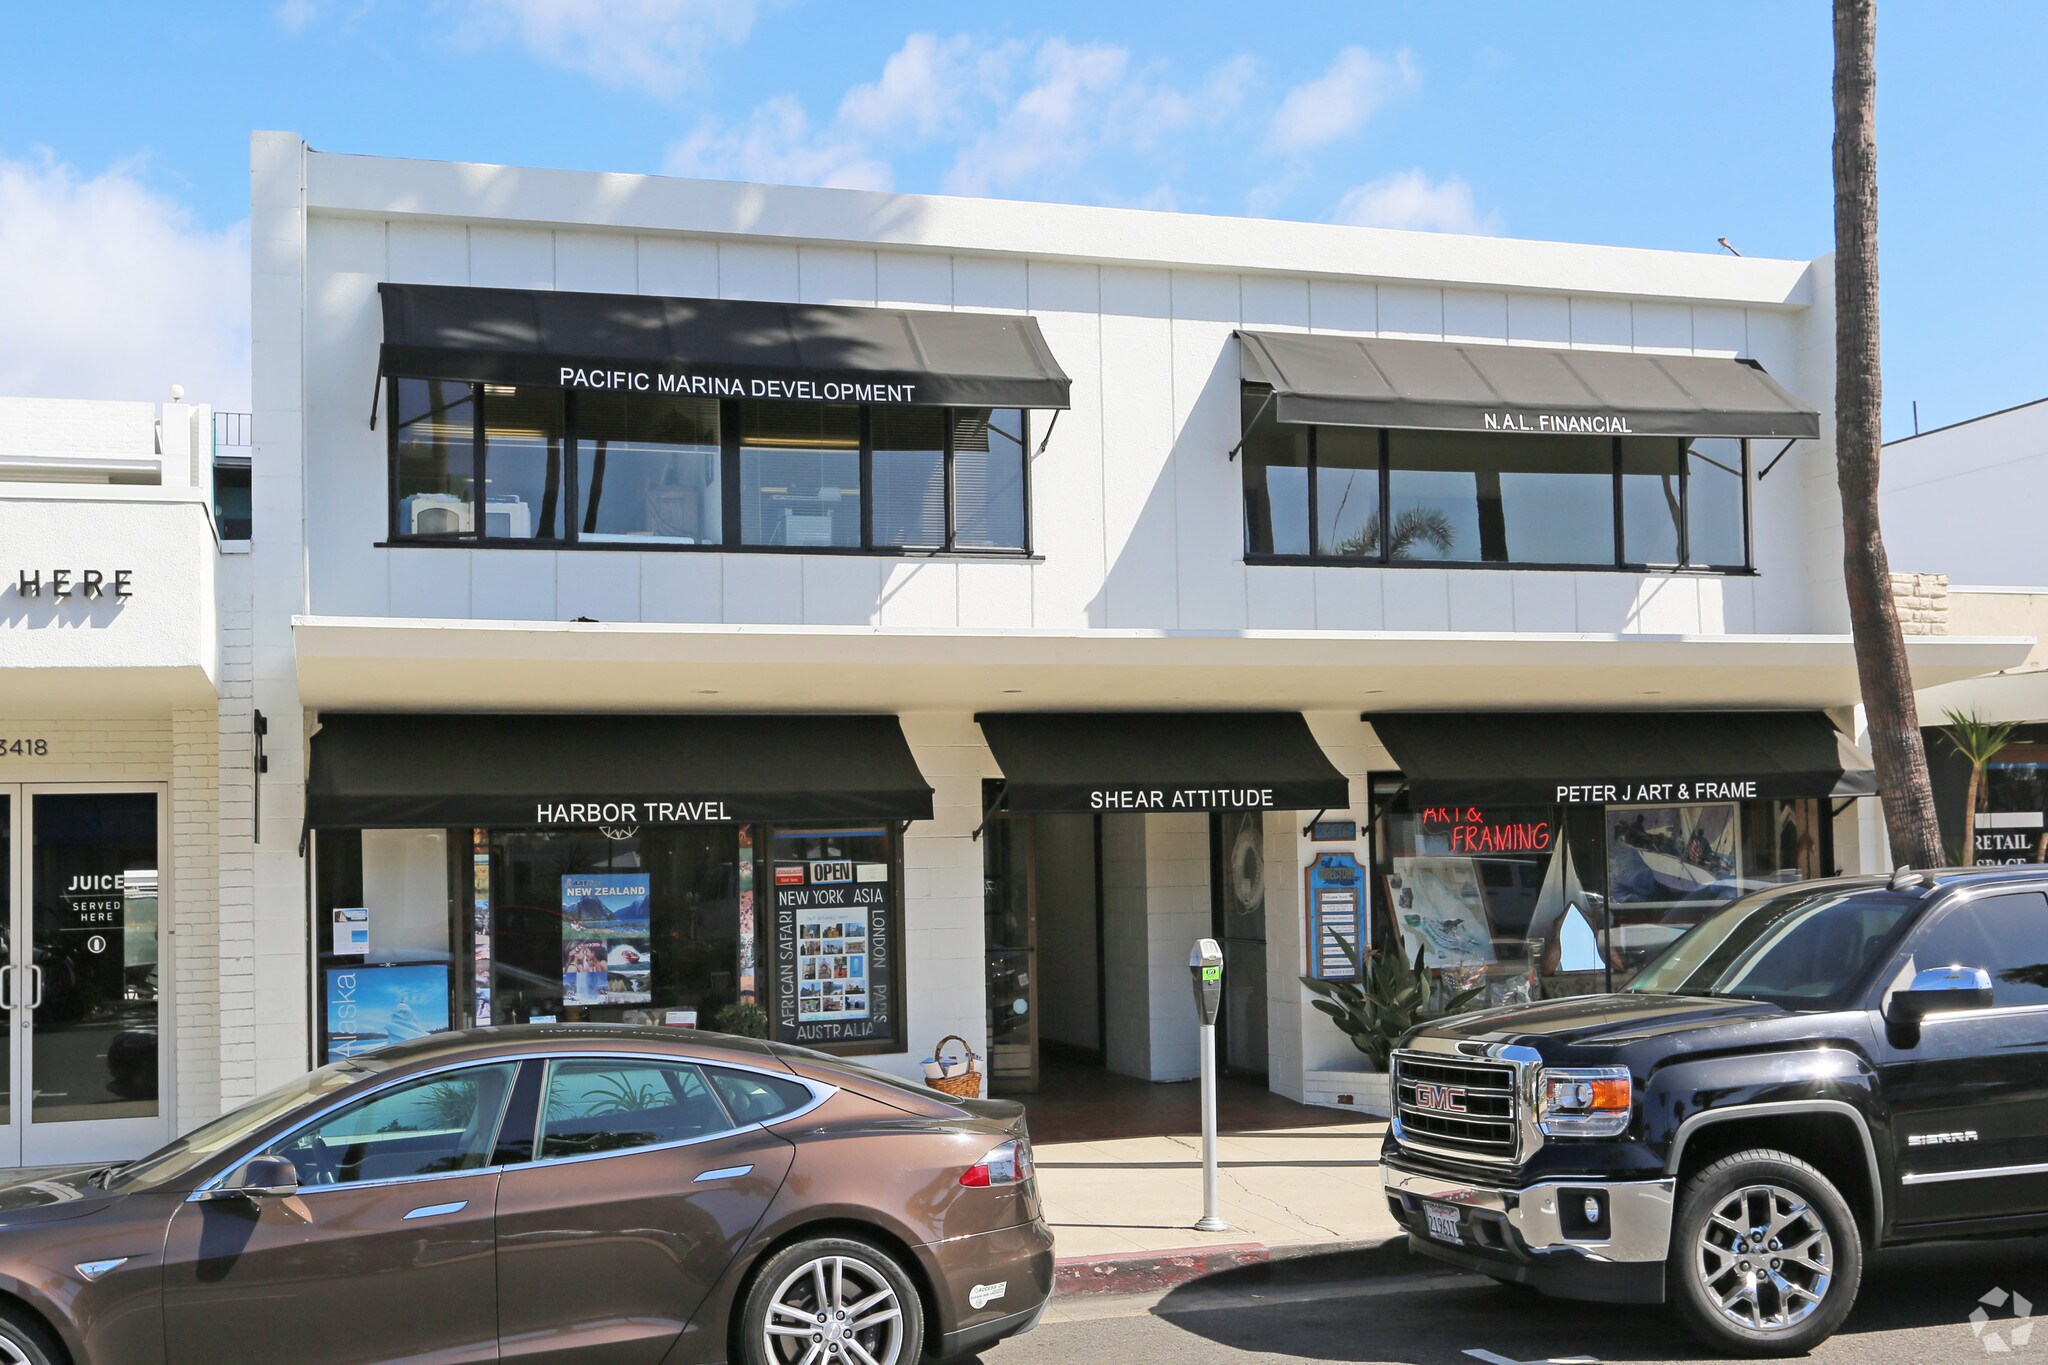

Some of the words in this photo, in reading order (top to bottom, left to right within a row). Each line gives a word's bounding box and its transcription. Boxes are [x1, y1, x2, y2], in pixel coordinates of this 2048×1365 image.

[560, 367, 650, 391] PACIFIC
[657, 373, 746, 396] MARINA
[751, 379, 915, 402] DEVELOPMENT
[1484, 413, 1533, 431] N.A.L.
[1539, 415, 1632, 433] FINANCIAL
[20, 569, 133, 597] HERE
[1090, 791, 1164, 809] SHEAR
[1172, 789, 1274, 807] ATTITUDE
[1556, 785, 1617, 802] PETER
[1622, 785, 1631, 801] J
[1637, 784, 1673, 800] ART
[1677, 783, 1690, 799] &
[1695, 782, 1757, 799] FRAME
[537, 803, 637, 823] HARBOR
[643, 801, 732, 821] TRAVEL
[1423, 807, 1460, 824] ART
[1466, 807, 1483, 823] &
[1451, 823, 1549, 851] FRAMING
[1975, 834, 2031, 850] RETAIL
[814, 862, 850, 882] OPEN
[68, 874, 124, 891] JUICE
[566, 887, 592, 896] NEW
[594, 886, 645, 896] ZEALAND
[72, 901, 121, 911] SERVED
[779, 890, 809, 906] NEW
[812, 889, 844, 905] YORK
[853, 888, 884, 903] ASIA
[81, 912, 113, 921] HERE
[778, 910, 793, 960] SAFARI
[872, 909, 886, 969] LONDON
[781, 964, 796, 1028] AFRICAN
[873, 984, 887, 1023] PARIS
[331, 972, 357, 1057] Alaska
[796, 1021, 874, 1040] AUSTRALIA
[1415, 1083, 1468, 1113] GMC
[1907, 1130, 1979, 1147] SIERRA
